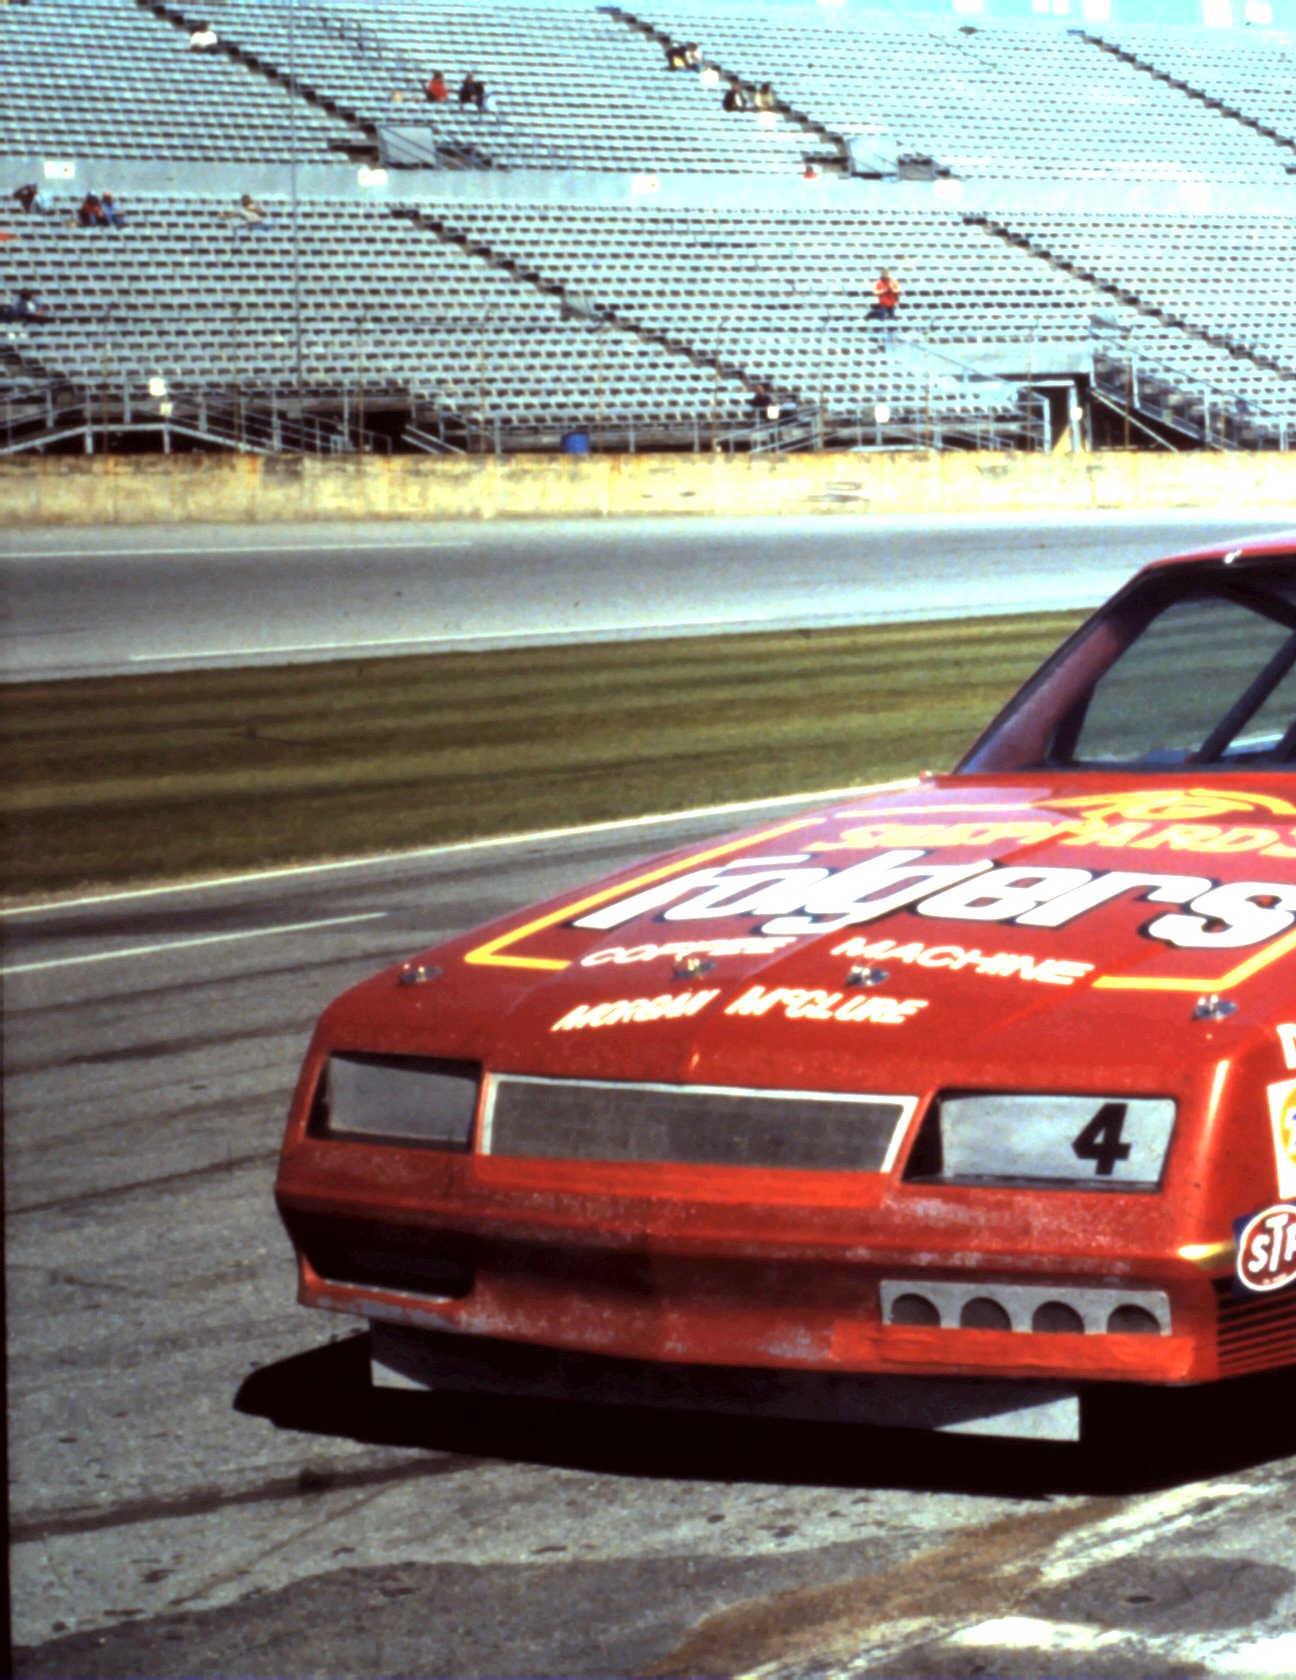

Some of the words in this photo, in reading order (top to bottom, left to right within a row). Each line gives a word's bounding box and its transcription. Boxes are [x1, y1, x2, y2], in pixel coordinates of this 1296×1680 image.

[580, 937, 798, 968] COFFEE
[830, 937, 1095, 985] MACHINE
[550, 988, 721, 1032] MORGAN
[1071, 1102, 1132, 1176] 4
